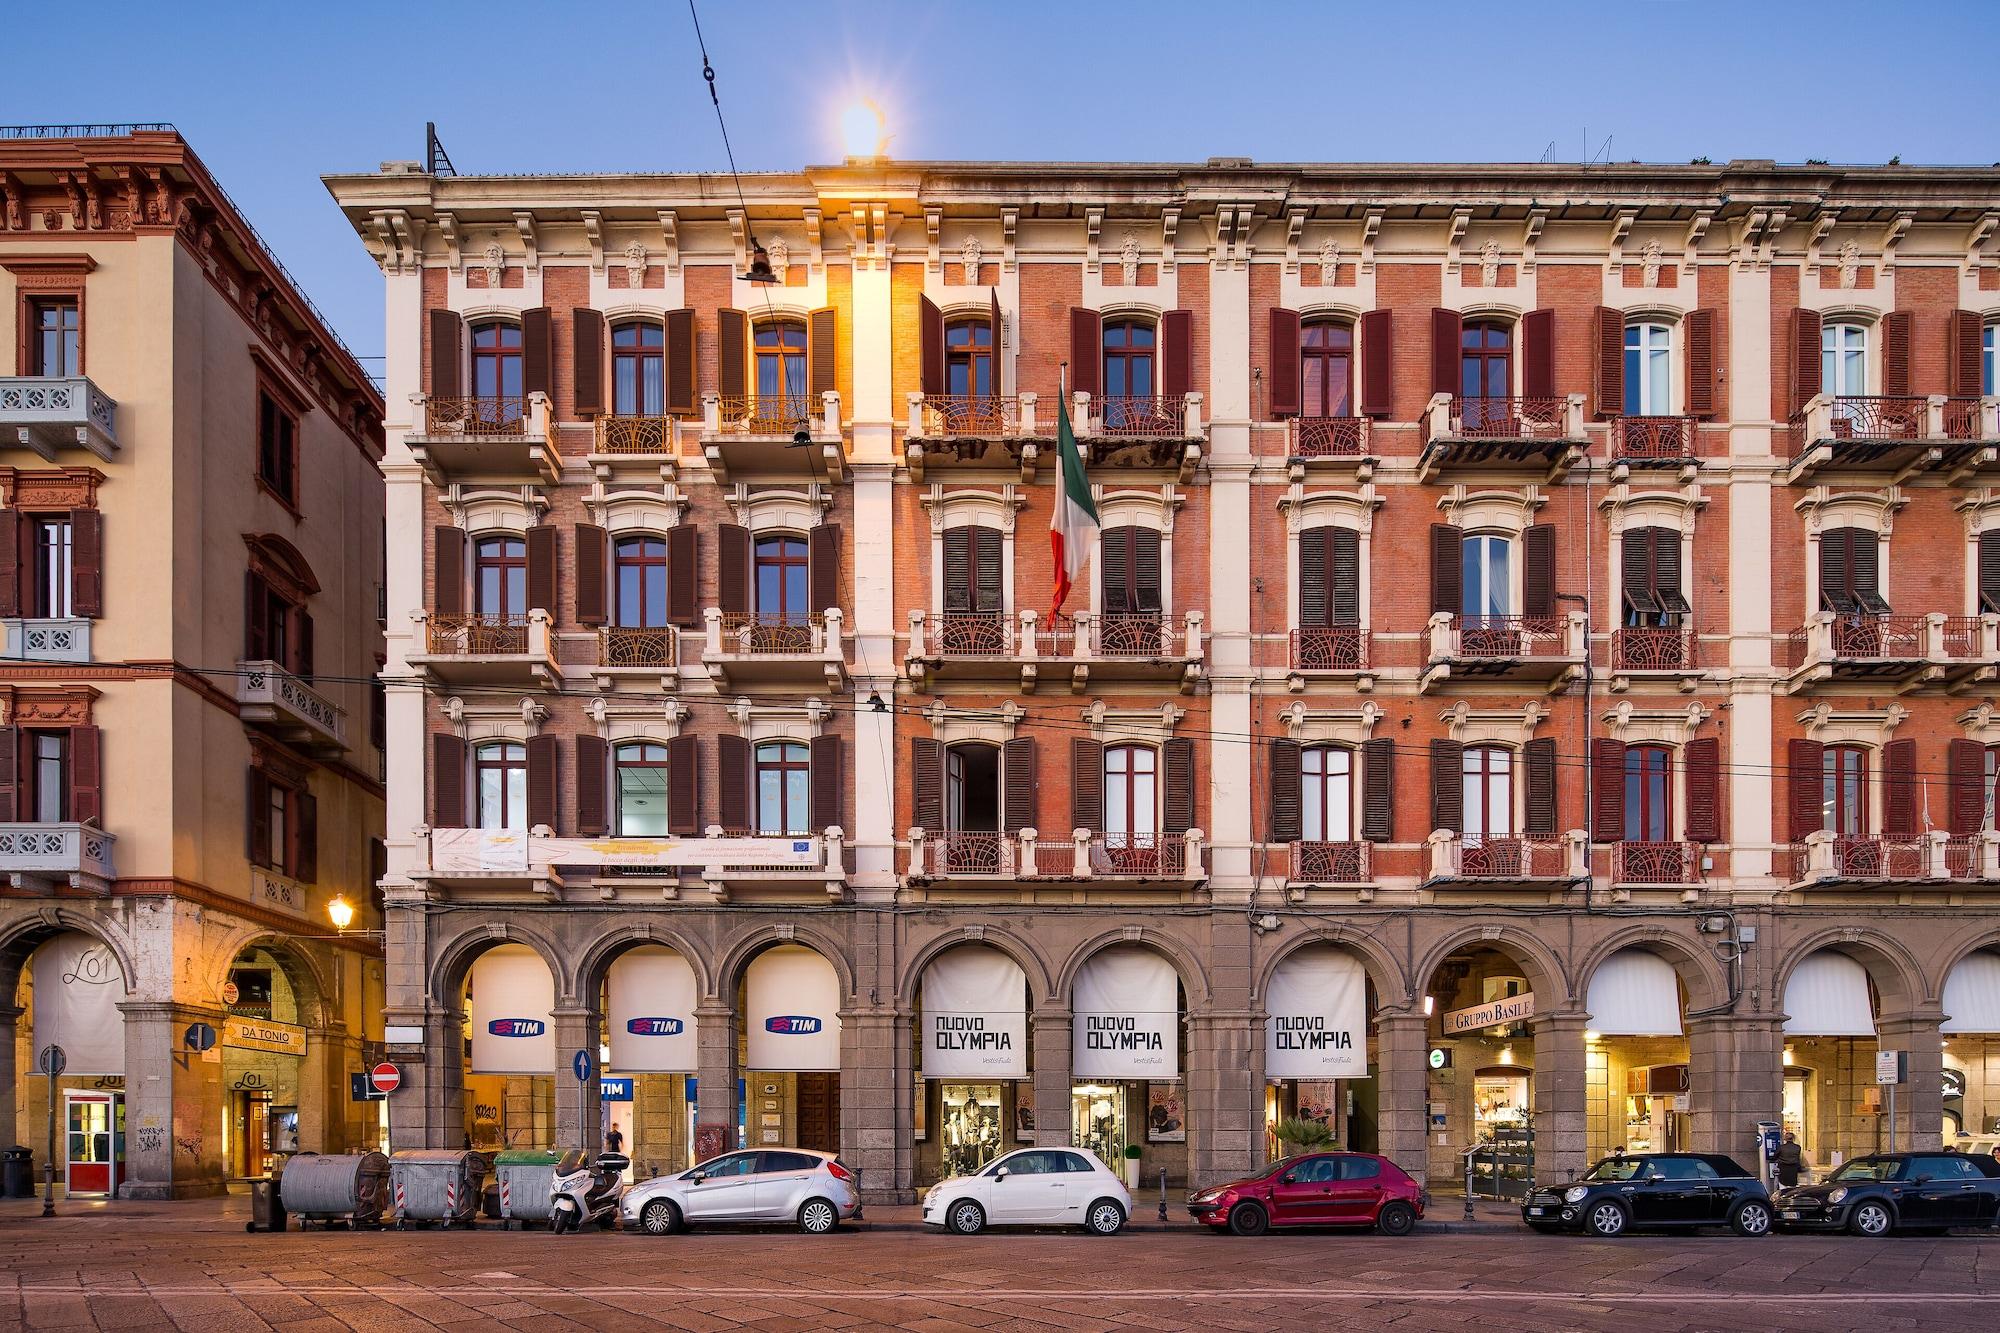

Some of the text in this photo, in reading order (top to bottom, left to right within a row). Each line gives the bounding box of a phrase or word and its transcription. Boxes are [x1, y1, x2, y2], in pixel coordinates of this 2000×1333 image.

[514, 1022, 538, 1034] TIM
[652, 1021, 677, 1033] TIM
[791, 1019, 815, 1031] TIM
[242, 1026, 290, 1042] DA TONIO
[937, 1032, 1011, 1050] OLYMPIA
[1087, 1032, 1162, 1050] OLYMPIA
[1276, 1032, 1351, 1050] OLYMPIA
[601, 1083, 623, 1095] TIM
